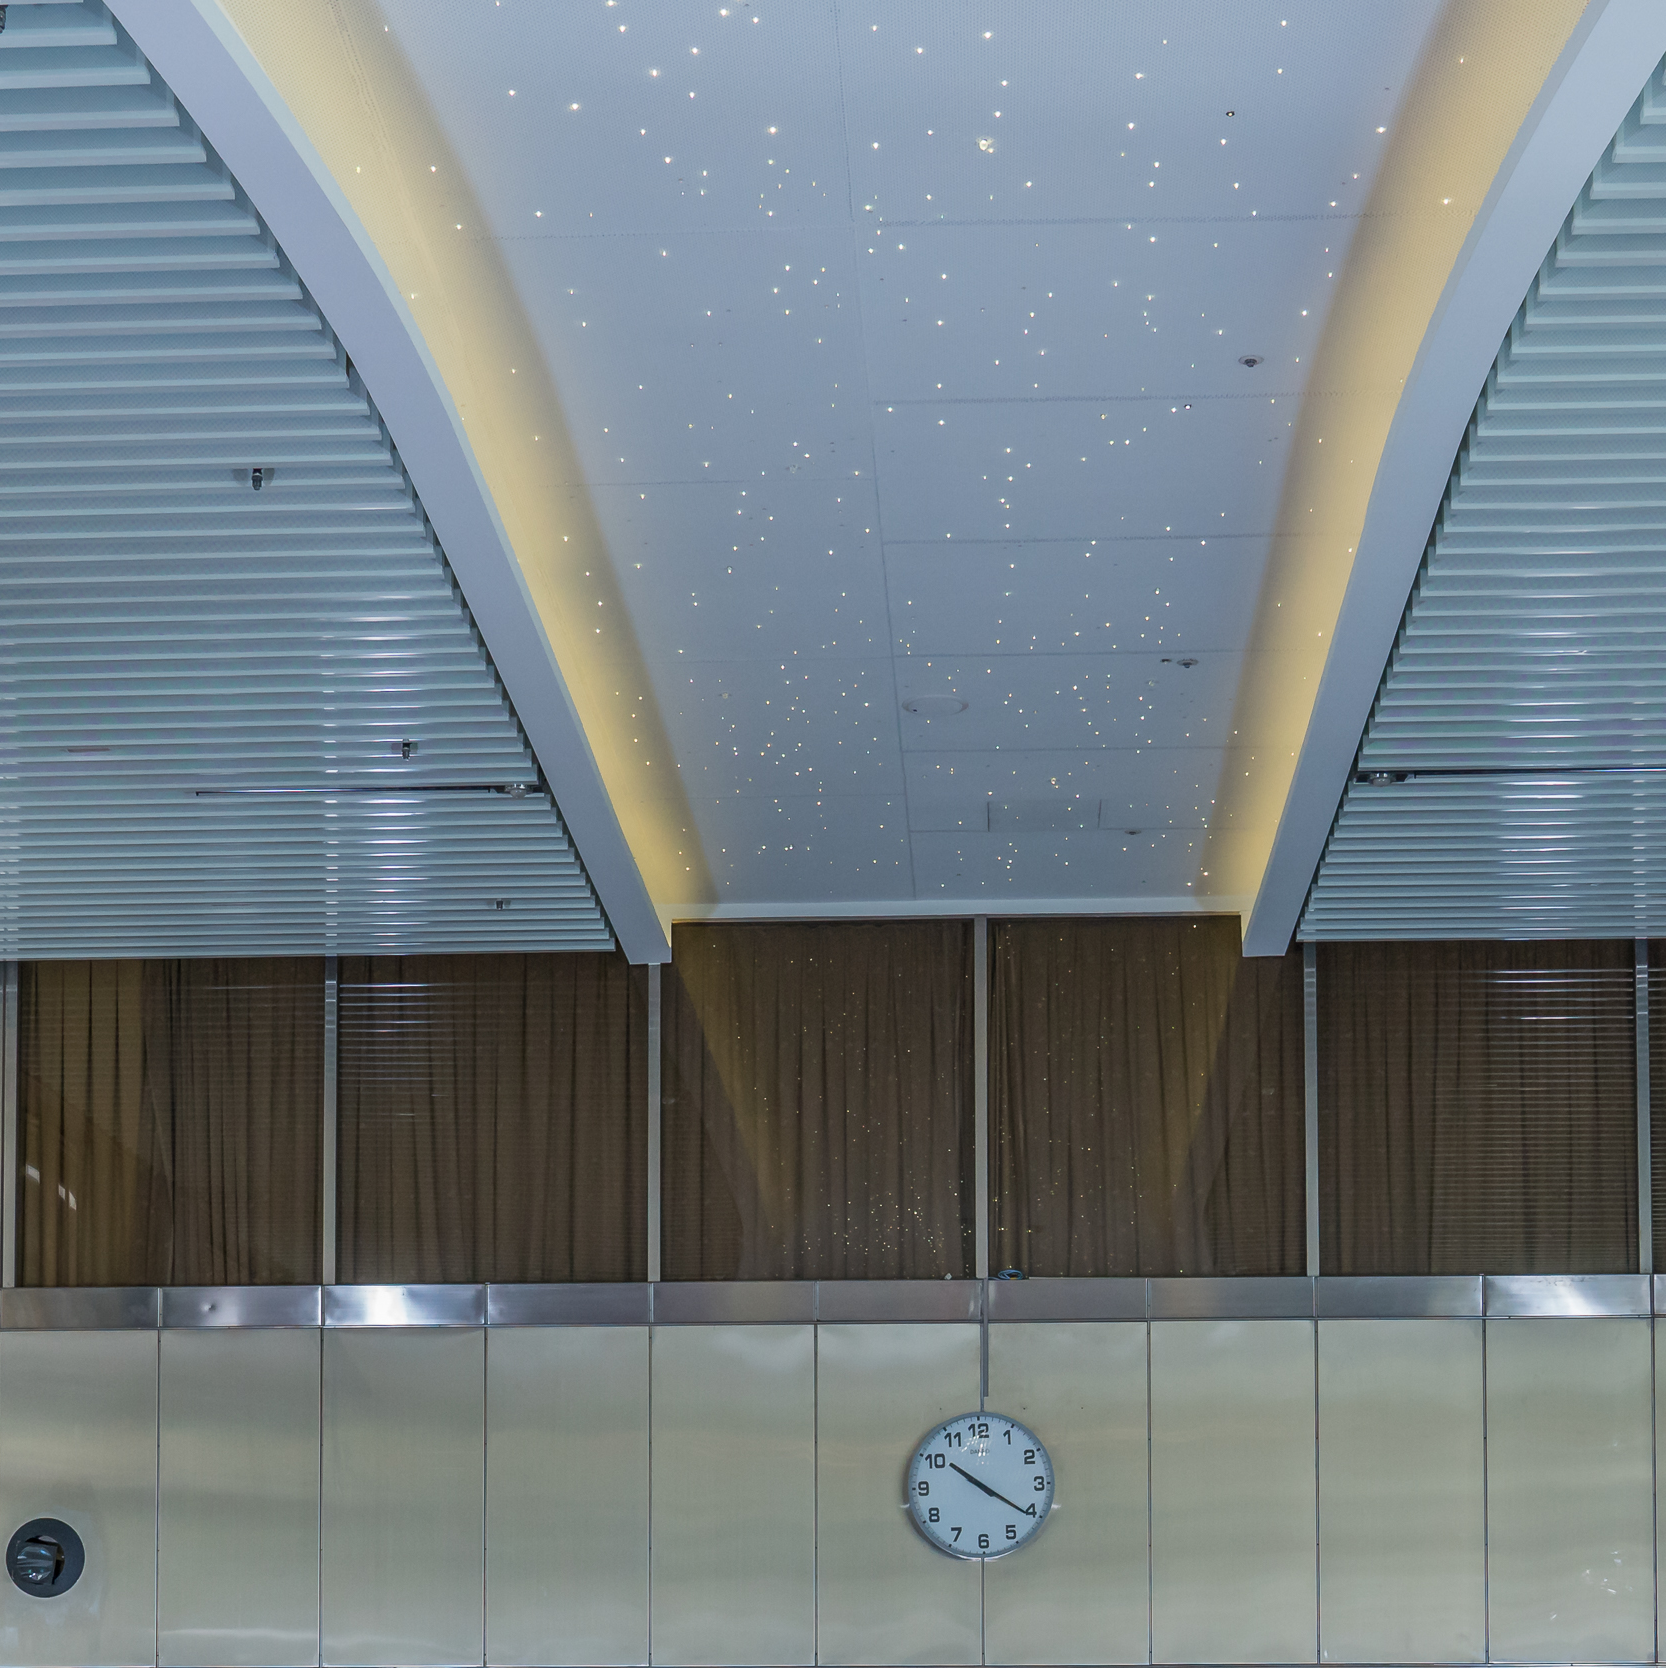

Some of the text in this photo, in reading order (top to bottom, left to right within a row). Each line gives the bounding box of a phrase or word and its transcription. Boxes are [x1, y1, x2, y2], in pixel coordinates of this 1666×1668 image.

[968, 1423, 989, 1438] 12
[1003, 1430, 1011, 1445] 1
[944, 1432, 961, 1447] 11
[925, 1454, 945, 1468] 10
[1024, 1450, 1035, 1464] 2
[918, 1481, 929, 1496] 9
[1034, 1476, 1044, 1491] 3
[929, 1508, 940, 1522] 8
[1025, 1503, 1037, 1518] 4
[951, 1527, 962, 1542] 7
[1006, 1525, 1016, 1540] 5
[978, 1534, 989, 1549] 6
